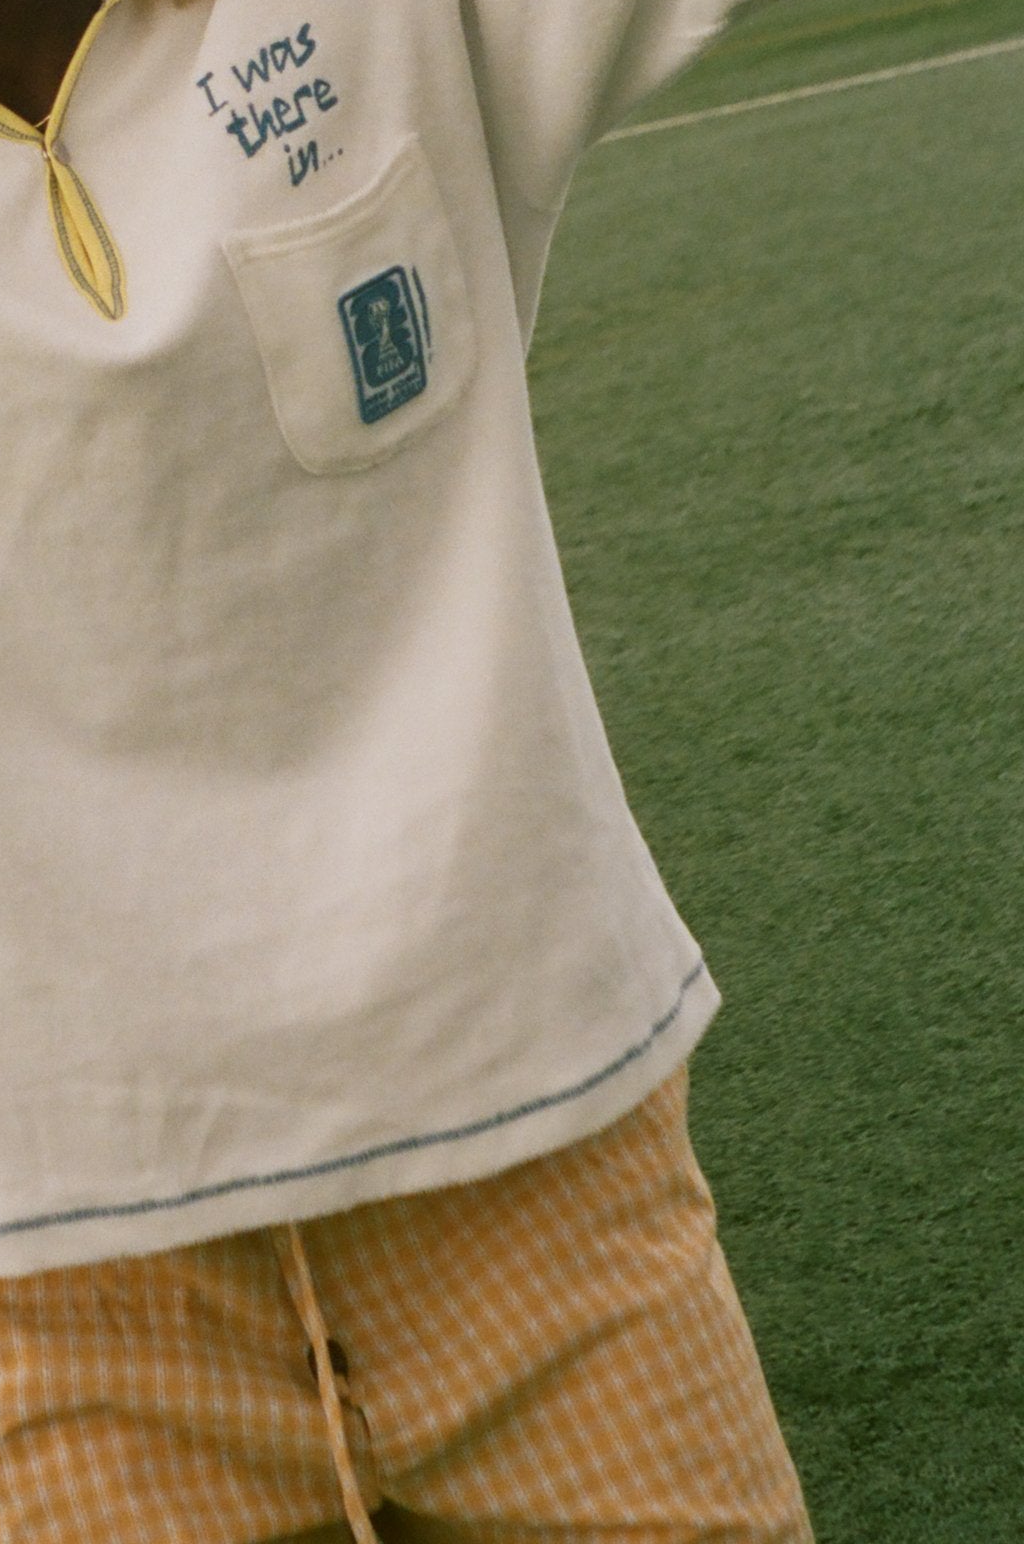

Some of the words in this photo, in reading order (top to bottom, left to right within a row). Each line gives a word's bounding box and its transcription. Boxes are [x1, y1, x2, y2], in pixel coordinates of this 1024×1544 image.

[195, 71, 229, 117] I
[231, 22, 316, 93] was
[225, 78, 339, 158] there
